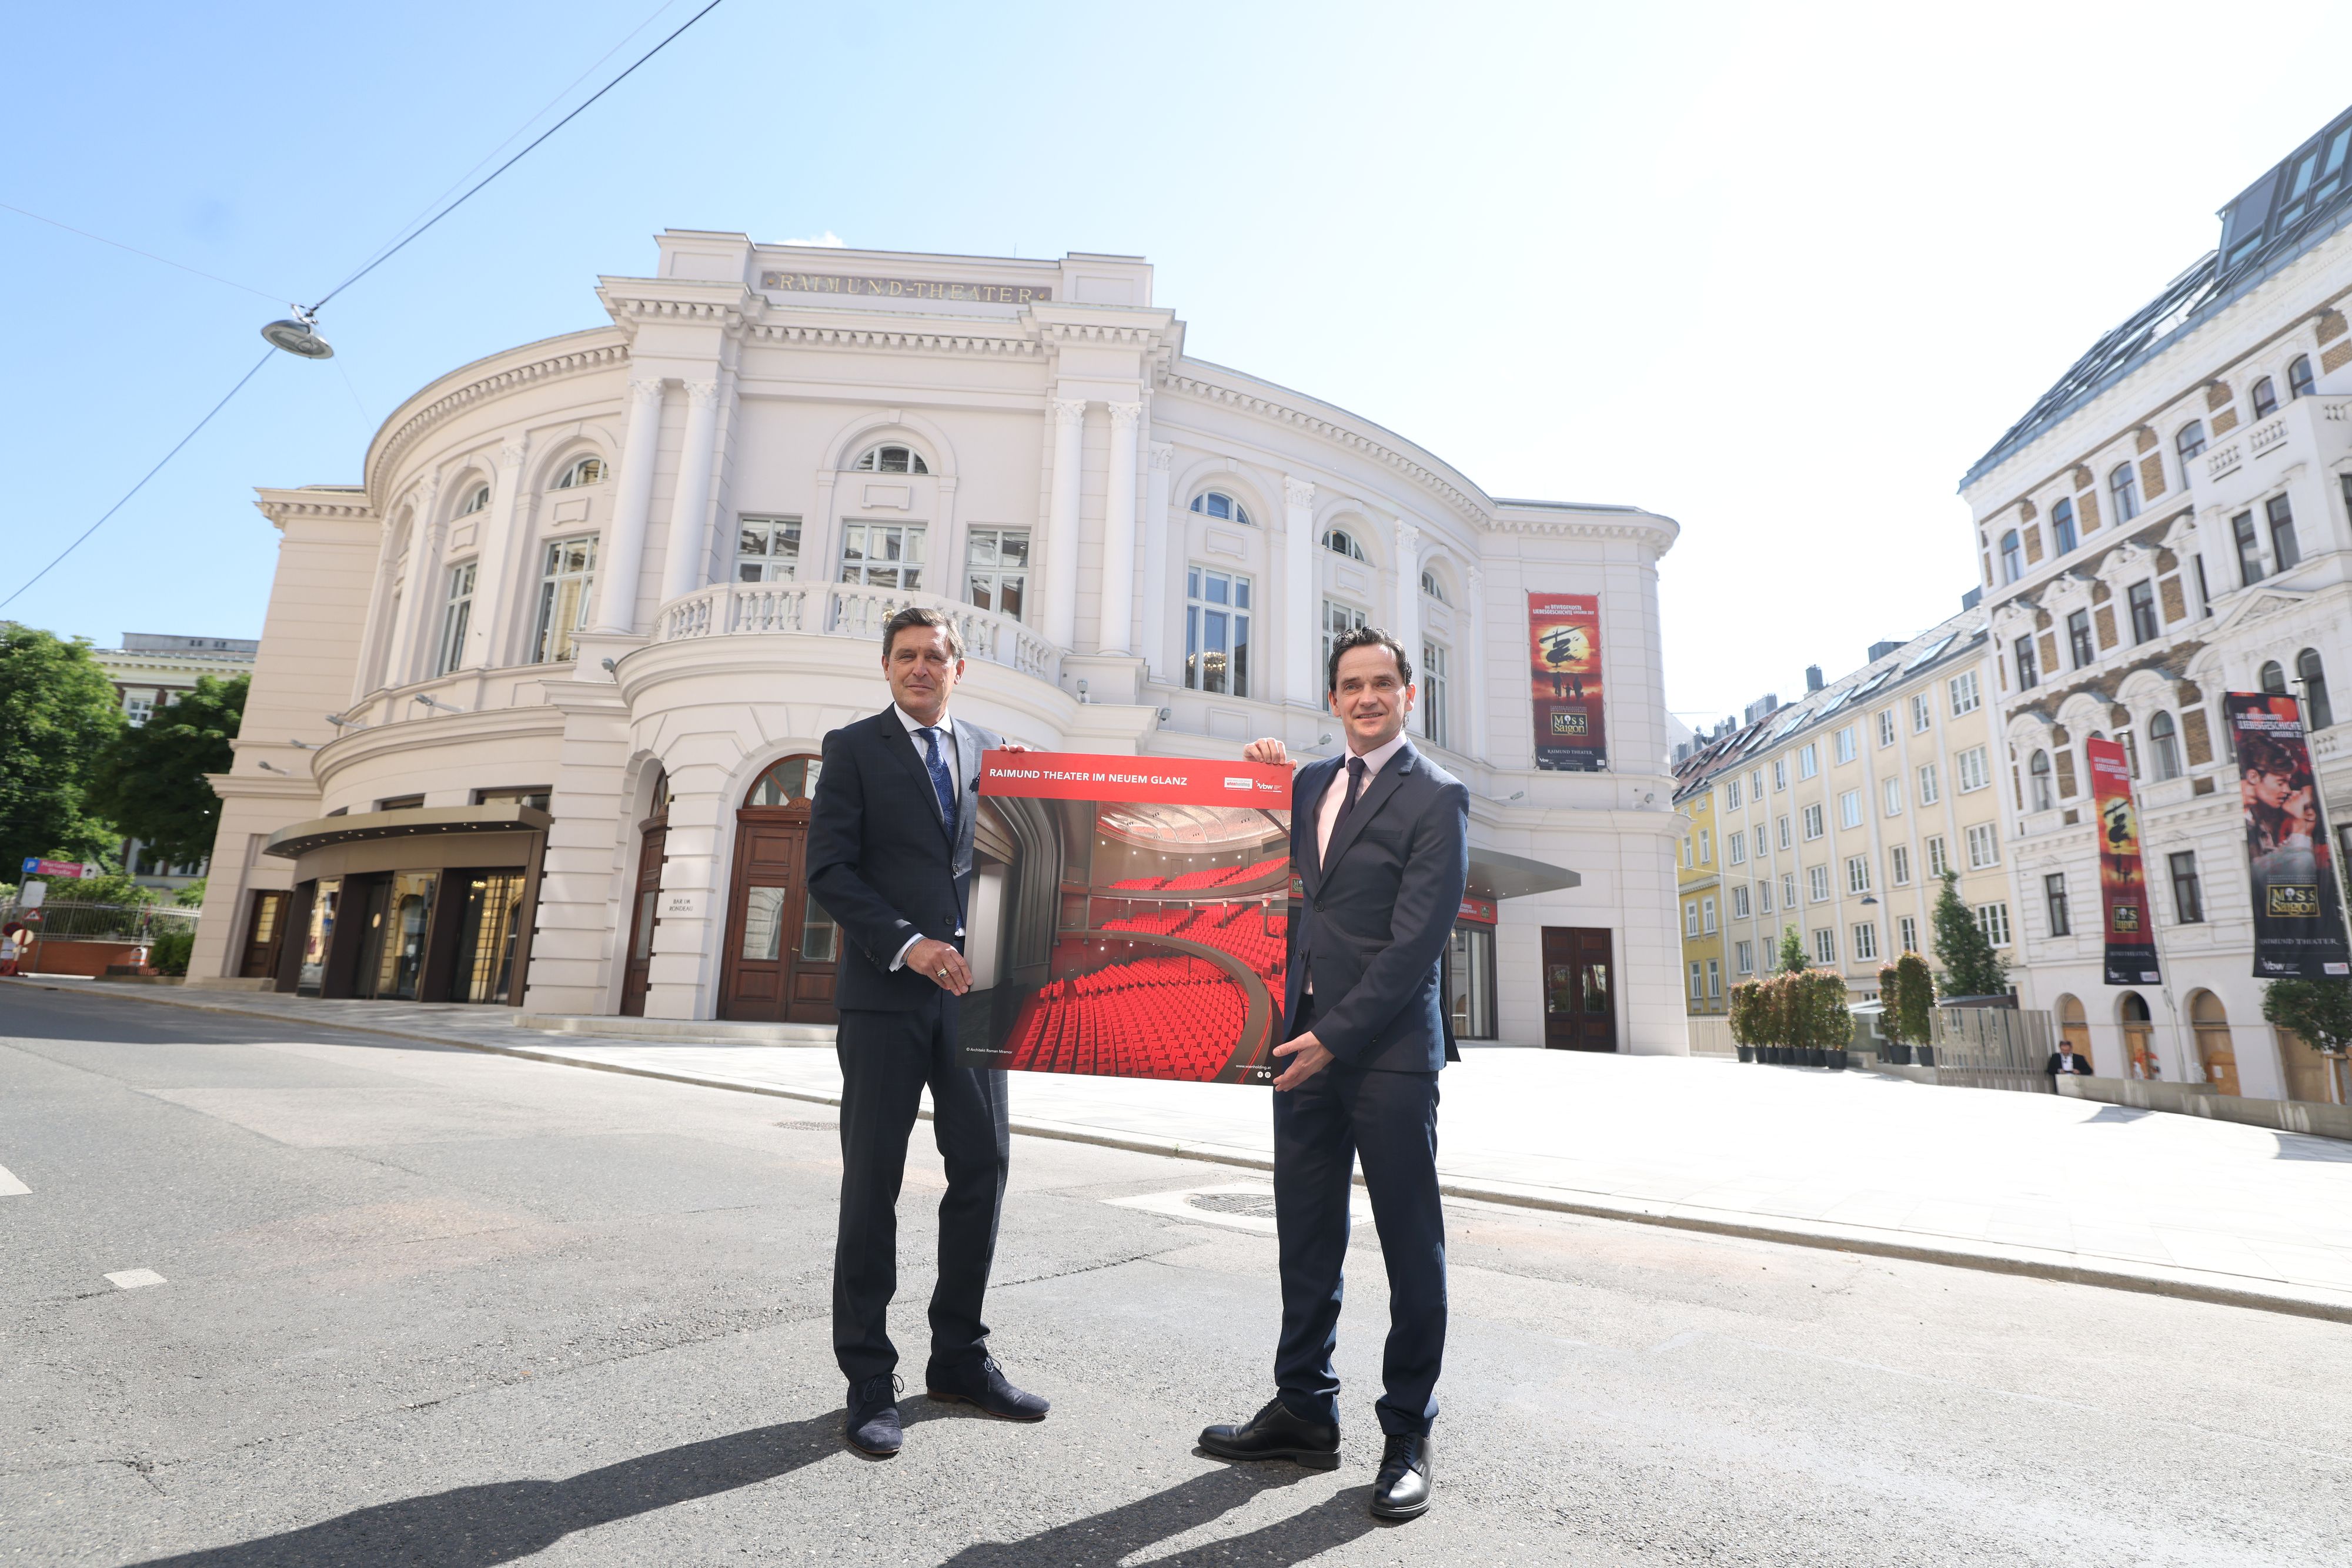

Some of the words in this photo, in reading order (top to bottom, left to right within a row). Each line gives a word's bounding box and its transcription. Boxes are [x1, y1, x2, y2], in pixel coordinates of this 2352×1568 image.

[780, 274, 1032, 303] RAIMUND-THEATER
[1554, 715, 1585, 725] Miss
[1554, 723, 1585, 734] Saigon
[989, 768, 1040, 779] RAIMUND
[1043, 771, 1089, 781] THEATER
[1093, 773, 1105, 782] IM
[1108, 774, 1147, 784] NEUEM
[1151, 775, 1188, 786] GLANZ
[1294, 885, 1304, 894] Saig
[2271, 888, 2316, 901] Miss
[2271, 900, 2316, 915] Saigon
